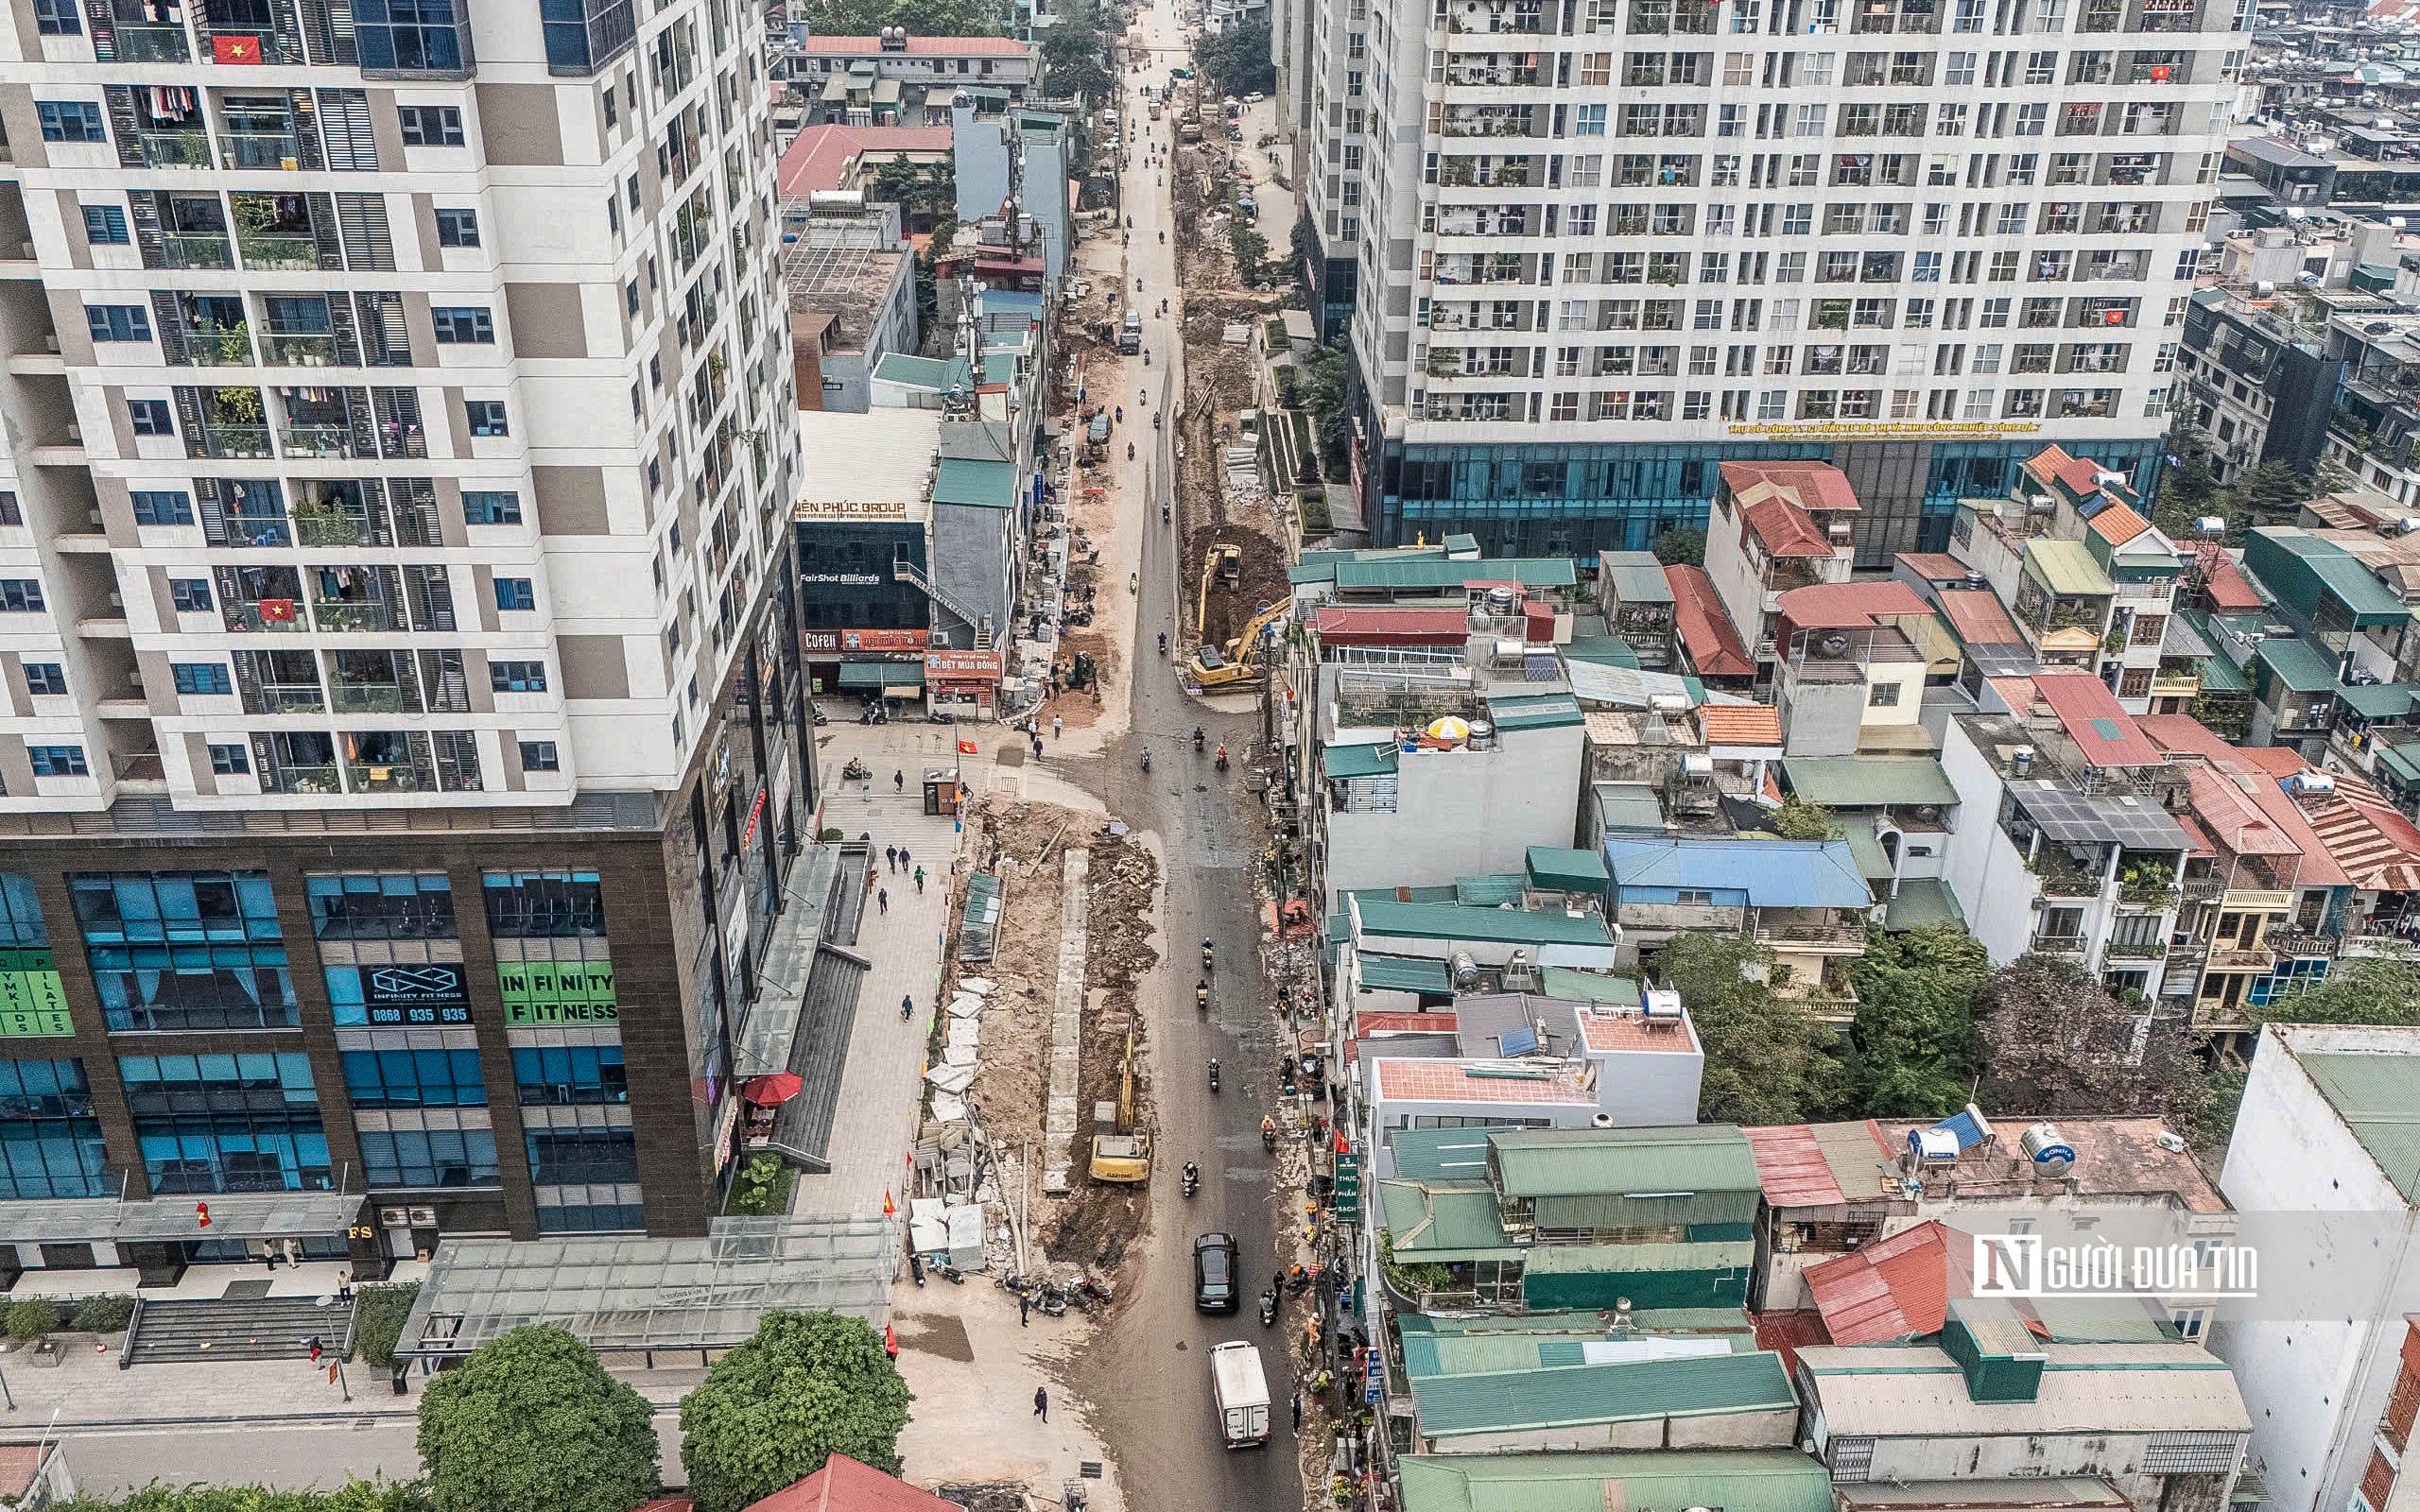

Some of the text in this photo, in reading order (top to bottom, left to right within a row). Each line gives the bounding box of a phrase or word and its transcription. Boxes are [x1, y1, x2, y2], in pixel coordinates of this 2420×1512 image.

[823, 499, 858, 512] PHÚC
[862, 503, 905, 512] GROUP
[801, 574, 880, 582] FairShot Billiards
[805, 633, 836, 647] Cofeli
[942, 660, 958, 671] DỆT
[958, 659, 976, 670] MÙA
[502, 974, 614, 991] INFINITY
[36, 958, 64, 1032] PILATES
[372, 1008, 467, 1022] 0868 935 935
[511, 1005, 618, 1021] FITNESS
